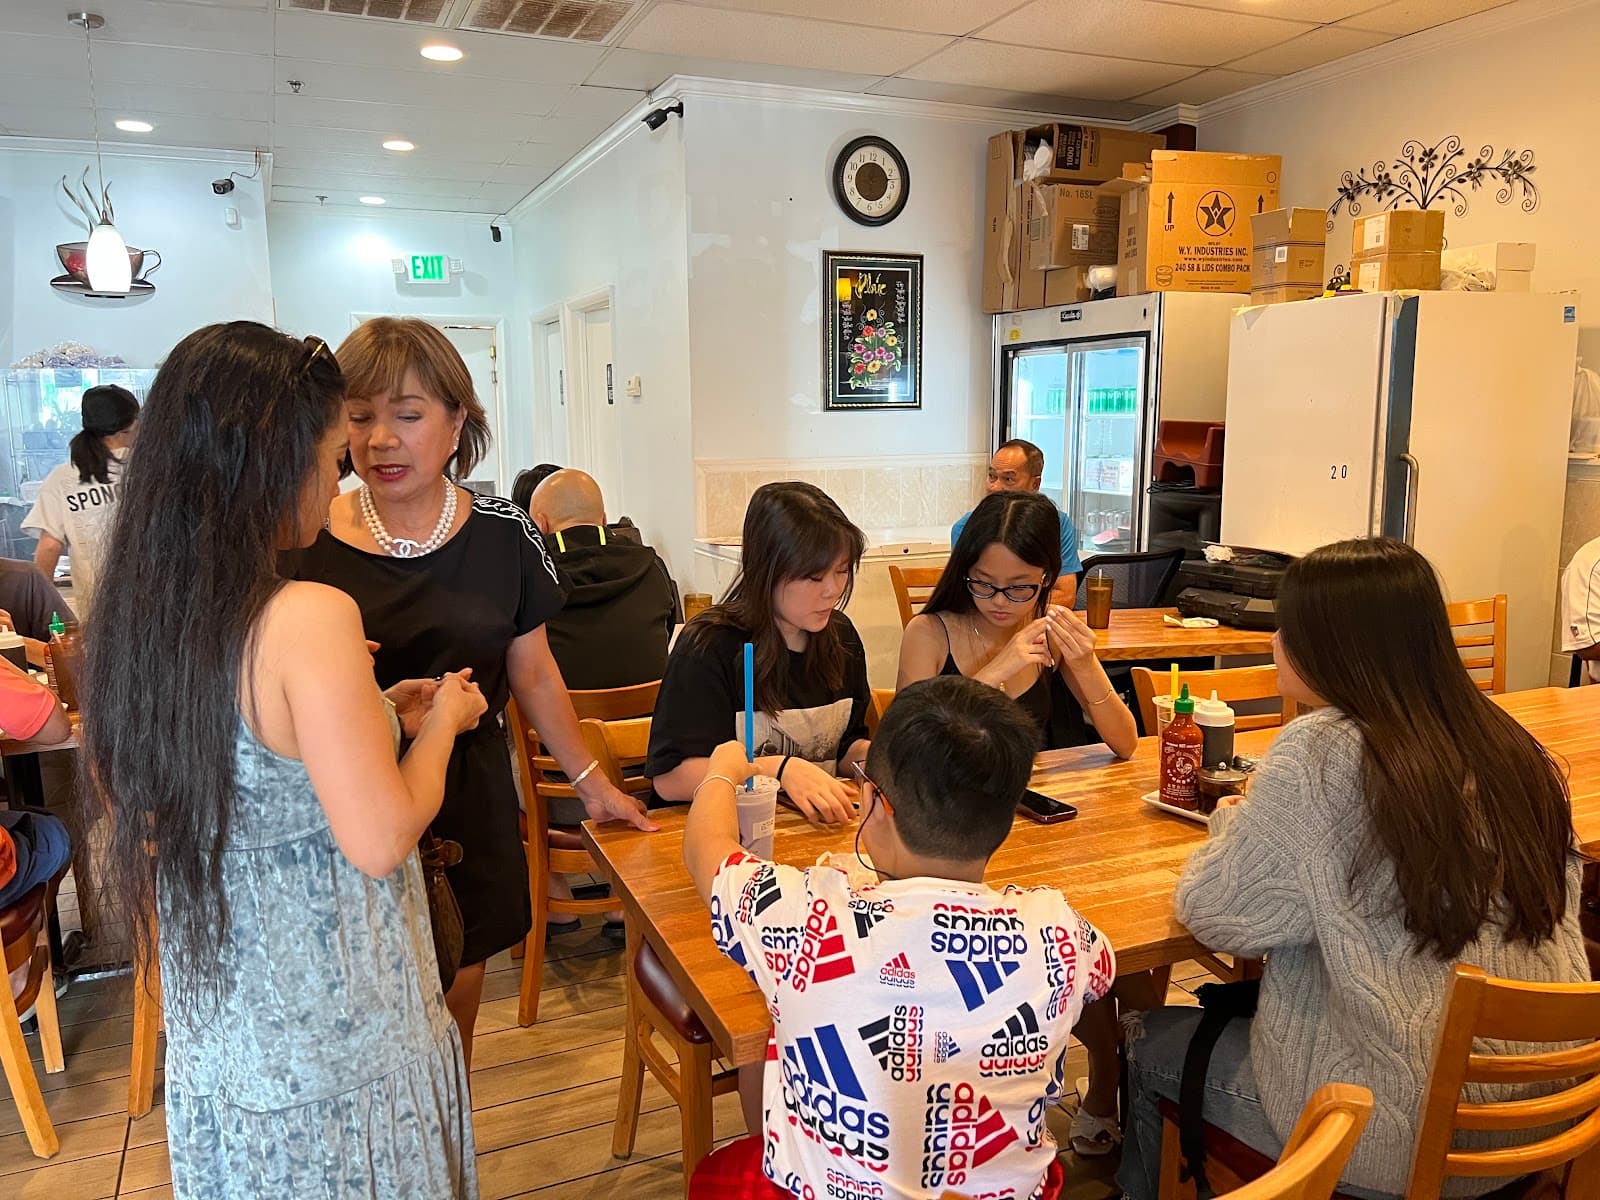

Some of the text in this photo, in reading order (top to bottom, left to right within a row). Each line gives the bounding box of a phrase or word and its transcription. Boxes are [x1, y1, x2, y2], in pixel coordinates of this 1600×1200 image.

[1059, 187, 1073, 198] No.
[1178, 246, 1248, 256] W.Y. INDUSTRIES INC.
[411, 256, 443, 280] EXIT
[1175, 263, 1186, 272] 240
[1201, 264, 1214, 272] LIDS
[1215, 264, 1236, 273] COMBO
[67, 484, 120, 511] SPON
[792, 898, 829, 993] adidas
[930, 931, 1028, 961] adidas
[880, 967, 916, 979] adidas
[1055, 925, 1077, 1014] adidas
[888, 1005, 907, 1081] adidas
[981, 1031, 1048, 1057] adidas
[782, 1058, 890, 1139] adidas
[947, 1082, 978, 1186] adidas
